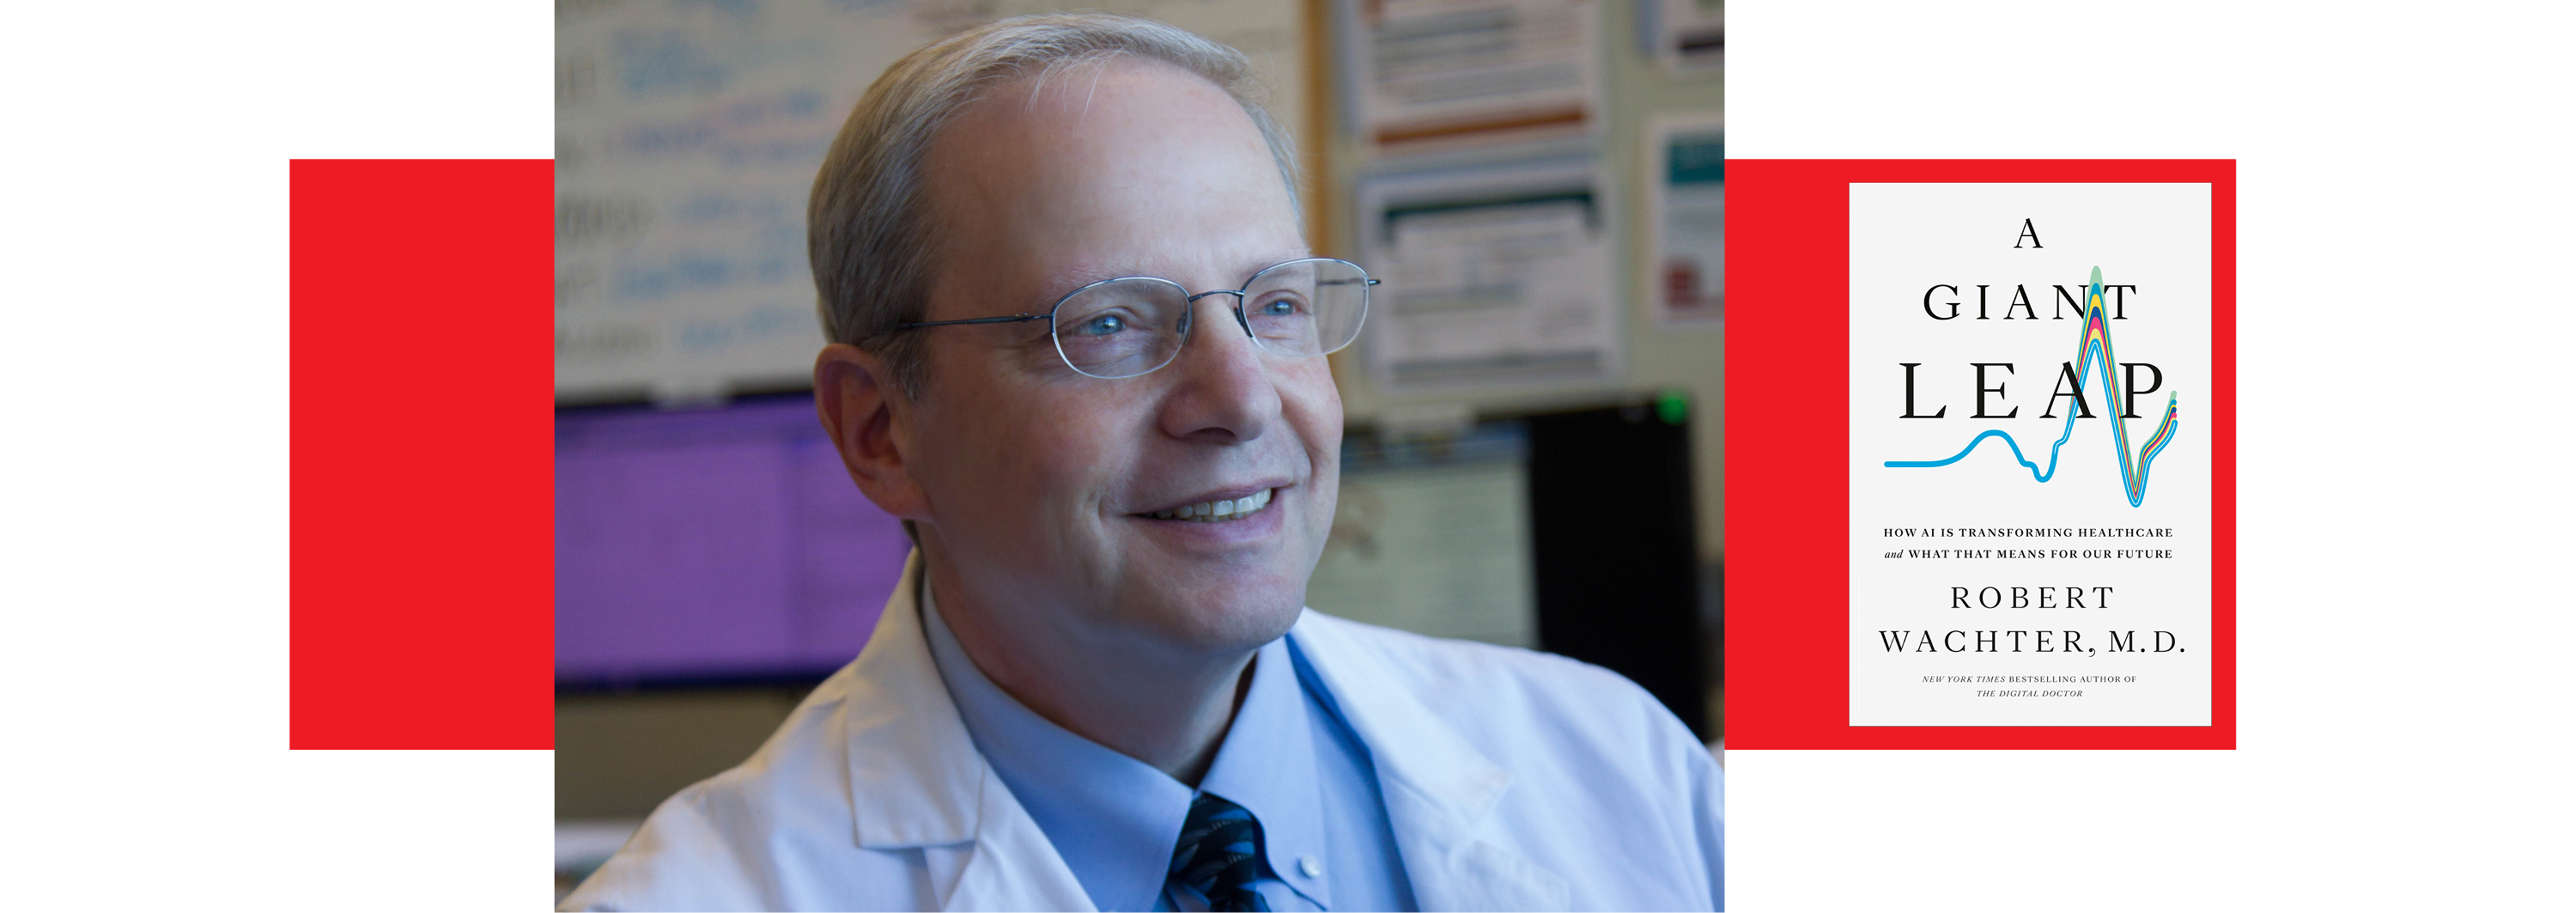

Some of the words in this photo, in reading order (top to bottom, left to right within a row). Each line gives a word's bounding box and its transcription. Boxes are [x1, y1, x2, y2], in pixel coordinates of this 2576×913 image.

[2014, 218, 2043, 248] A
[1923, 284, 2136, 320] GIANT
[1899, 361, 2163, 419] LEAP
[1884, 528, 1917, 538] HOW
[1921, 528, 1935, 538] AI
[1941, 528, 1954, 538] IS
[1959, 528, 2073, 538] TRANSFORMING
[2078, 528, 2173, 538] HEALTHCARE
[1884, 549, 1905, 559] and
[1908, 549, 1950, 559] WHAT
[1953, 549, 1992, 559] THAT
[1996, 549, 2045, 559] MEANS
[2050, 549, 2078, 559] FOR
[2082, 549, 2112, 559] OUR
[2117, 549, 2172, 559] FUTURE
[1951, 587, 2113, 609] ROBERT
[1879, 630, 2096, 658] WACHTER,
[2108, 630, 2185, 654] M.D.
